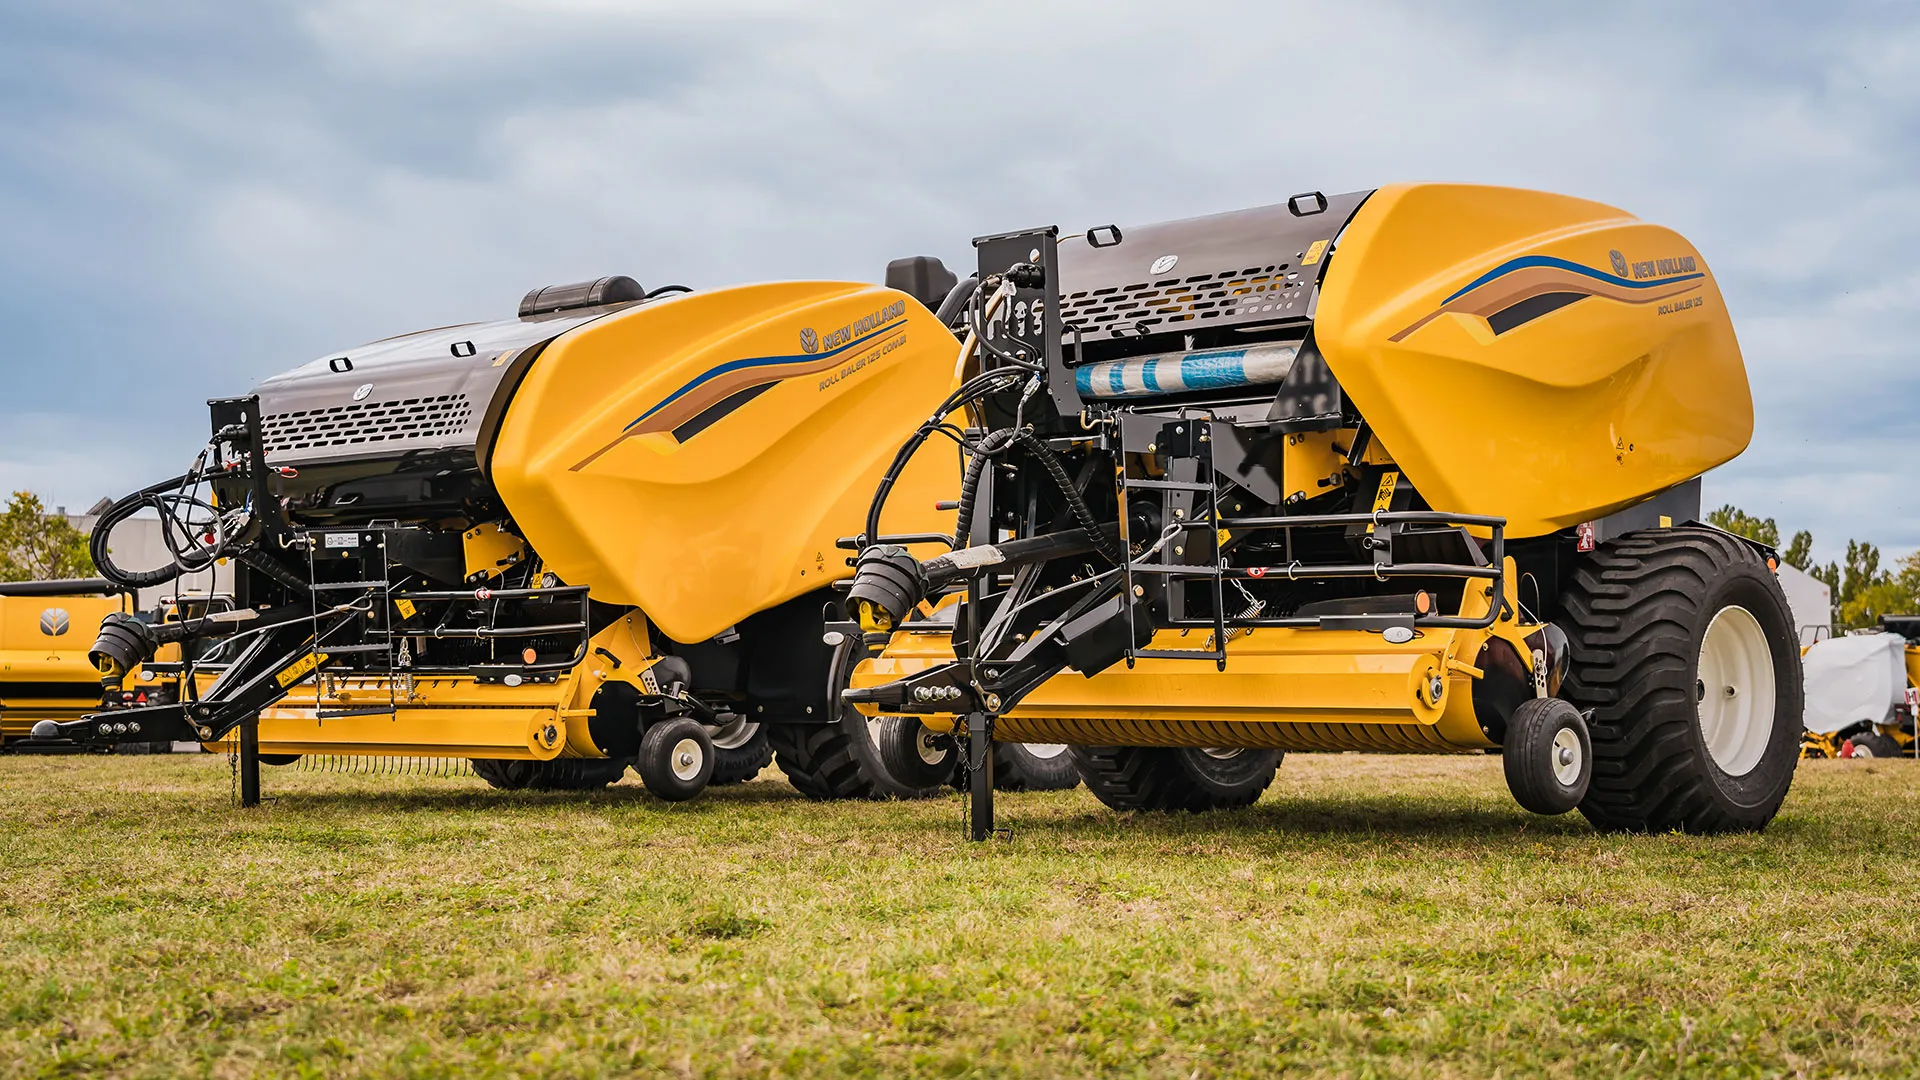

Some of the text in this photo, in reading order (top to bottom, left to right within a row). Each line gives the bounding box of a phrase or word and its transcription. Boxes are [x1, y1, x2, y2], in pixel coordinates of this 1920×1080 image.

[1632, 256, 1696, 279] NEW HOLLAND
[1658, 297, 1703, 315] ROLL BALER 125
[822, 300, 905, 351] NEW HOLLAND
[819, 335, 907, 391] ROLL BALER 125 COMBI
